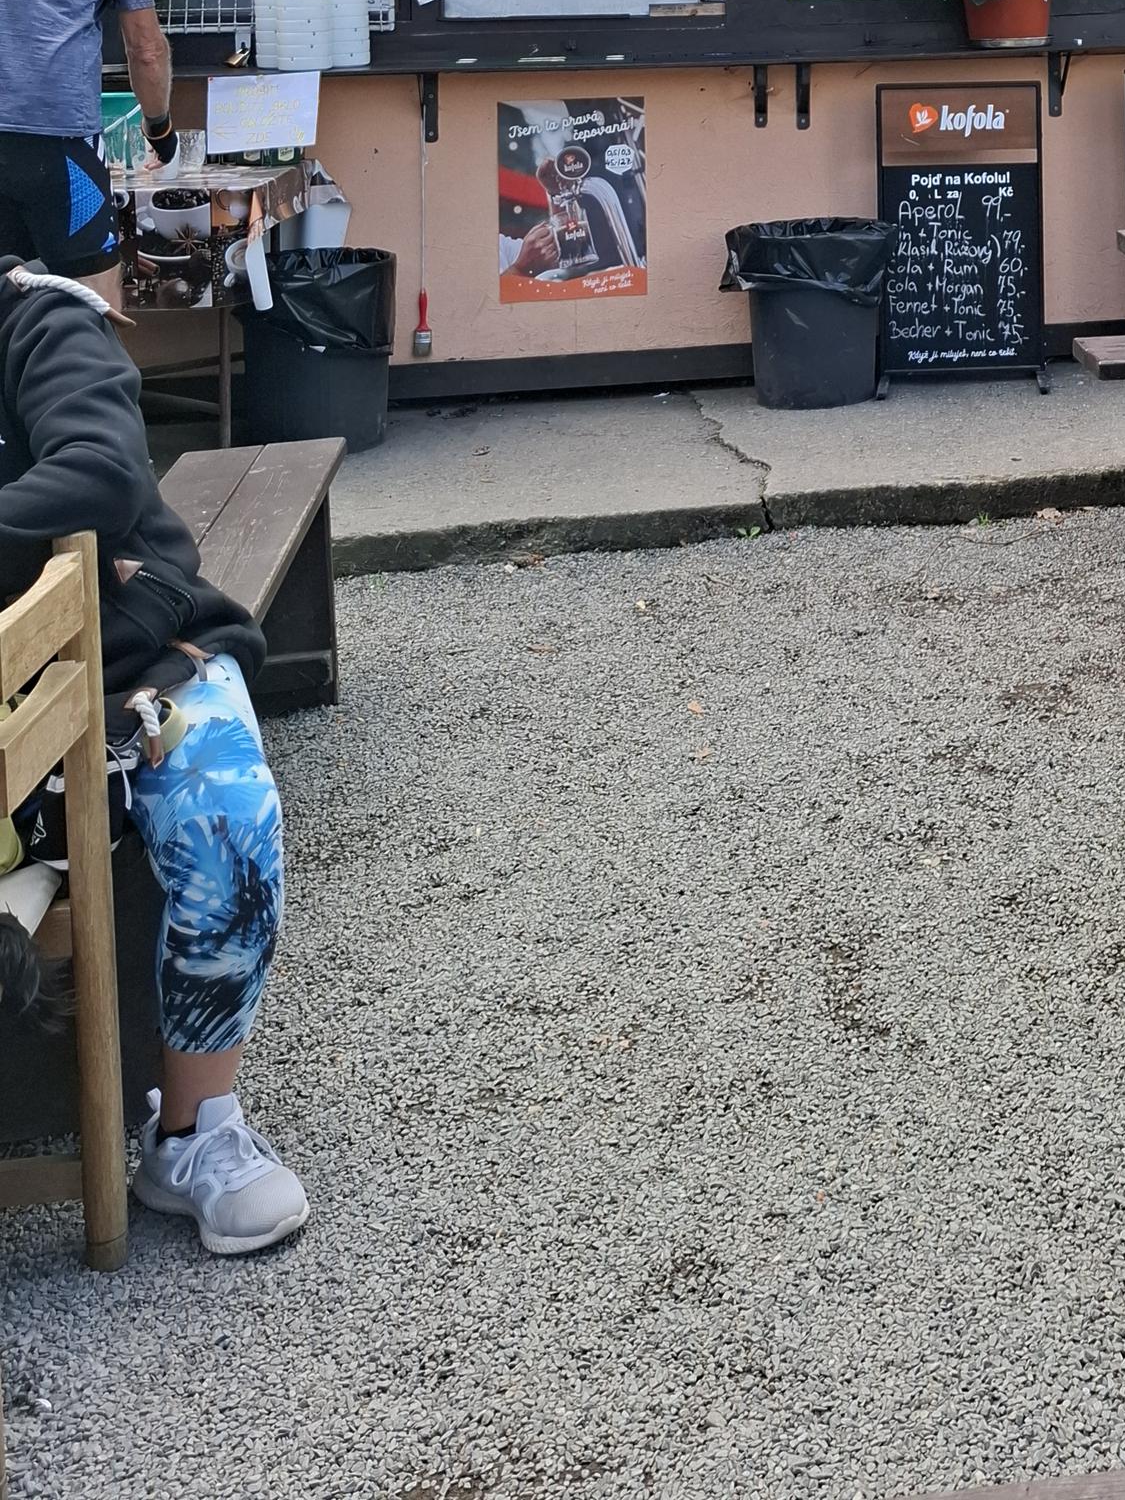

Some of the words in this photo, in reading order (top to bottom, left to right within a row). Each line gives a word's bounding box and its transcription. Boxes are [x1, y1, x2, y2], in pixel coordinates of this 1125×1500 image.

[508, 124, 541, 139] Jsem
[545, 119, 558, 131] ta
[573, 116, 634, 142] čepovaná!
[939, 104, 1006, 138] kofola
[911, 174, 942, 188] Pojď
[946, 175, 960, 185] na
[964, 171, 1010, 185] Kofolu!
[947, 190, 959, 199] za
[999, 186, 1014, 197] Kč
[929, 222, 972, 241] Tonic
[944, 259, 978, 276] Rum
[887, 276, 917, 293] Cola
[889, 293, 938, 315] Fernet
[889, 318, 941, 340] Becher
[953, 321, 995, 342] Tonic
[908, 350, 929, 363] Když
